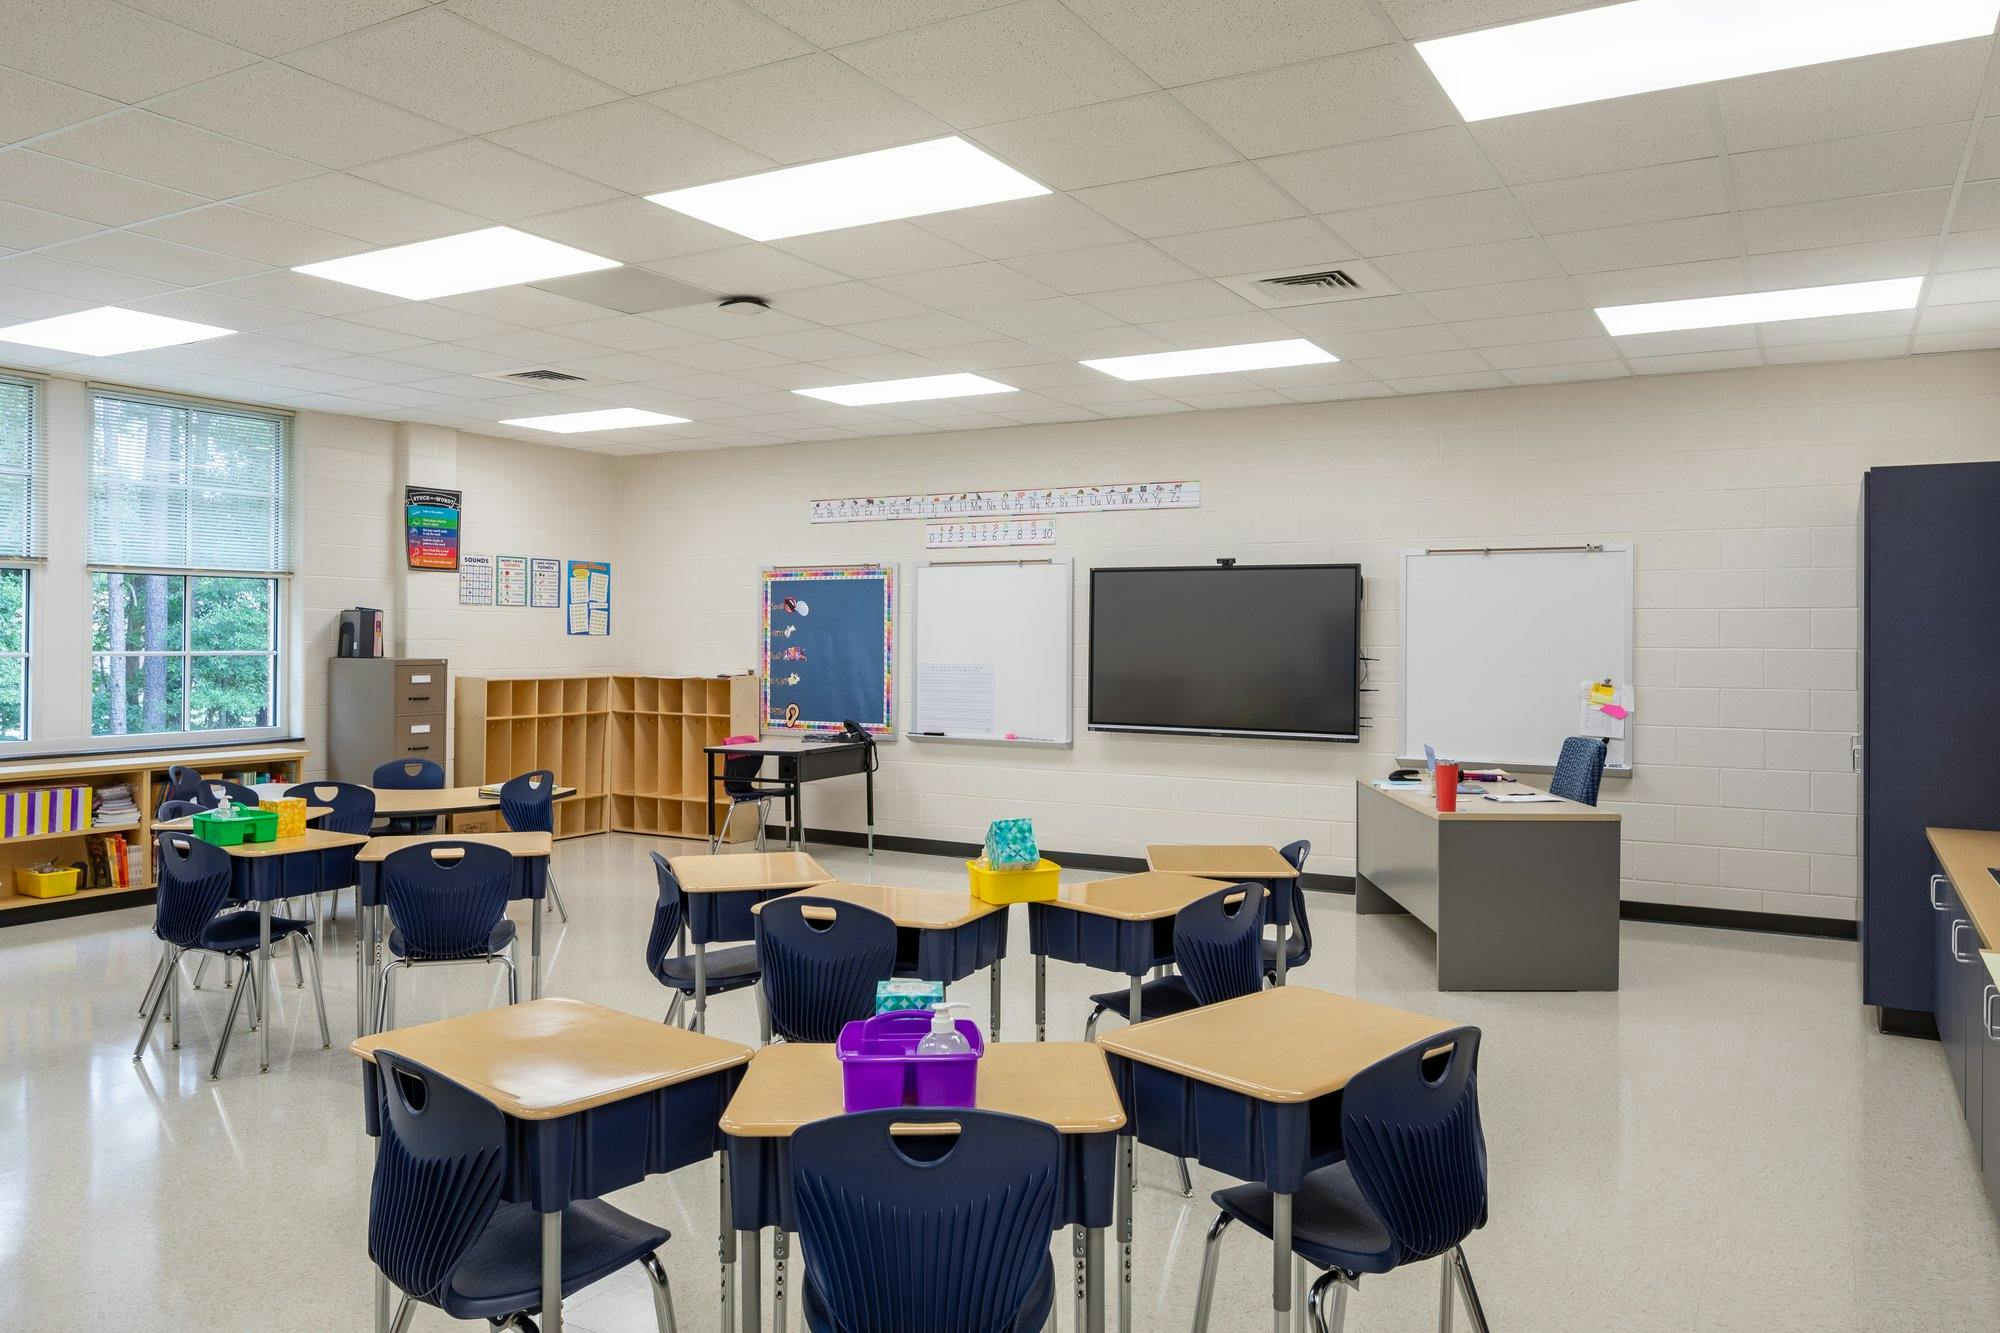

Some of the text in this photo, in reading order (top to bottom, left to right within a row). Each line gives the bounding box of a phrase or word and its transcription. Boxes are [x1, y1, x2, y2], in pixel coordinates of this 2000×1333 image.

[930, 528, 1052, 543] 0 1 2 3 4 5 6 7 8 9 10
